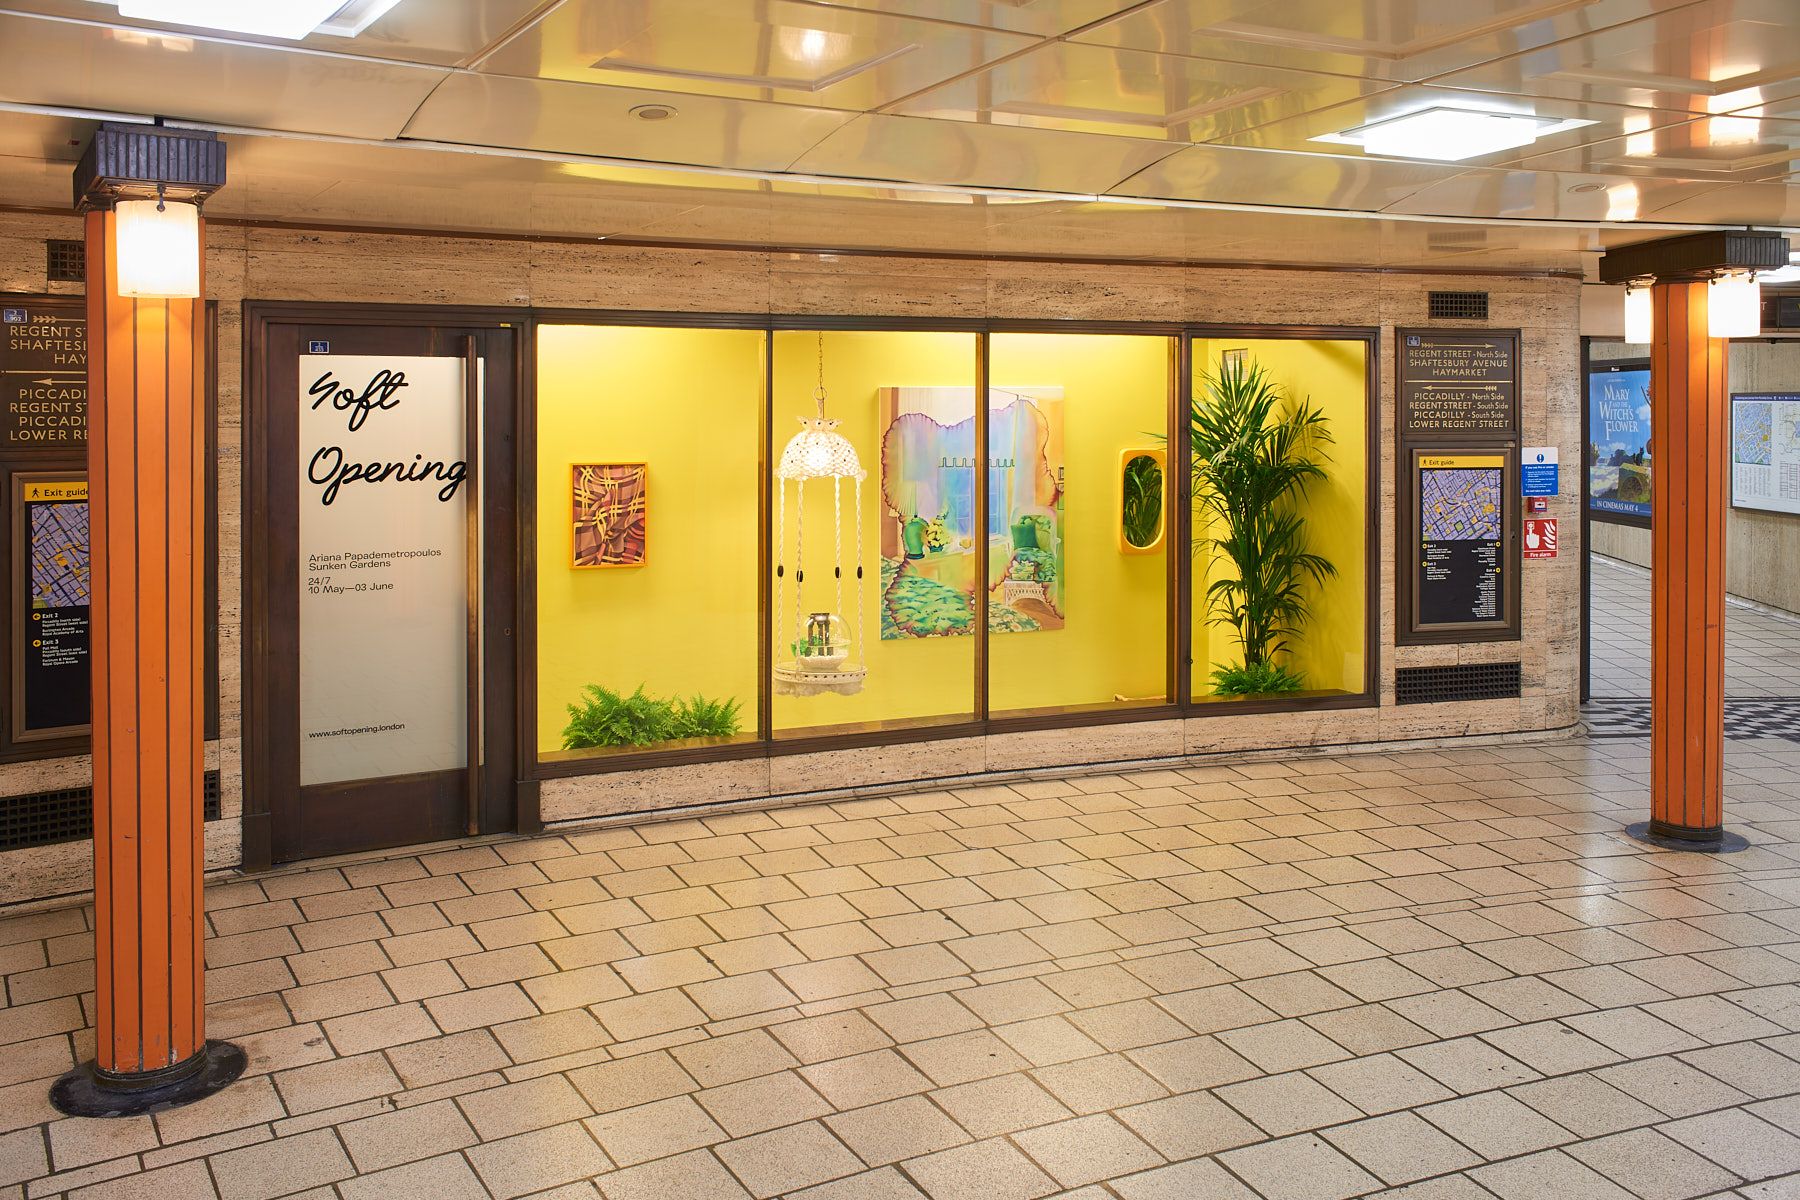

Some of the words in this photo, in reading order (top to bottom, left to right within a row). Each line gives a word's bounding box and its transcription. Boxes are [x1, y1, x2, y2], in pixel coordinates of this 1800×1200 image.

[10, 326, 71, 337] REGENT
[75, 327, 86, 338] S
[10, 340, 86, 351] SHAFTES
[54, 354, 87, 364] HAY
[1409, 350, 1441, 358] REGENT
[1444, 350, 1472, 358] STREET
[1409, 359, 1468, 367] SHAFTESBURY
[20, 389, 86, 399] PICCADI
[1604, 384, 1630, 400] MARY
[309, 369, 408, 432] Soft
[10, 403, 71, 413] REGENT
[75, 403, 87, 413] S
[1472, 411, 1490, 419] South
[20, 416, 86, 427] PICCADI
[10, 430, 67, 441] LOWER
[1604, 421, 1638, 440] FLOWER
[308, 446, 466, 506] Opening
[1603, 501, 1624, 510] CINEMAS
[309, 554, 341, 562] Ariana
[344, 549, 442, 561] Papademetropoulos
[309, 562, 346, 571] Sunken
[350, 560, 391, 569] Gardens
[308, 577, 330, 586] 24/7
[308, 586, 319, 594] 10
[309, 723, 405, 738] www.softopening.london
